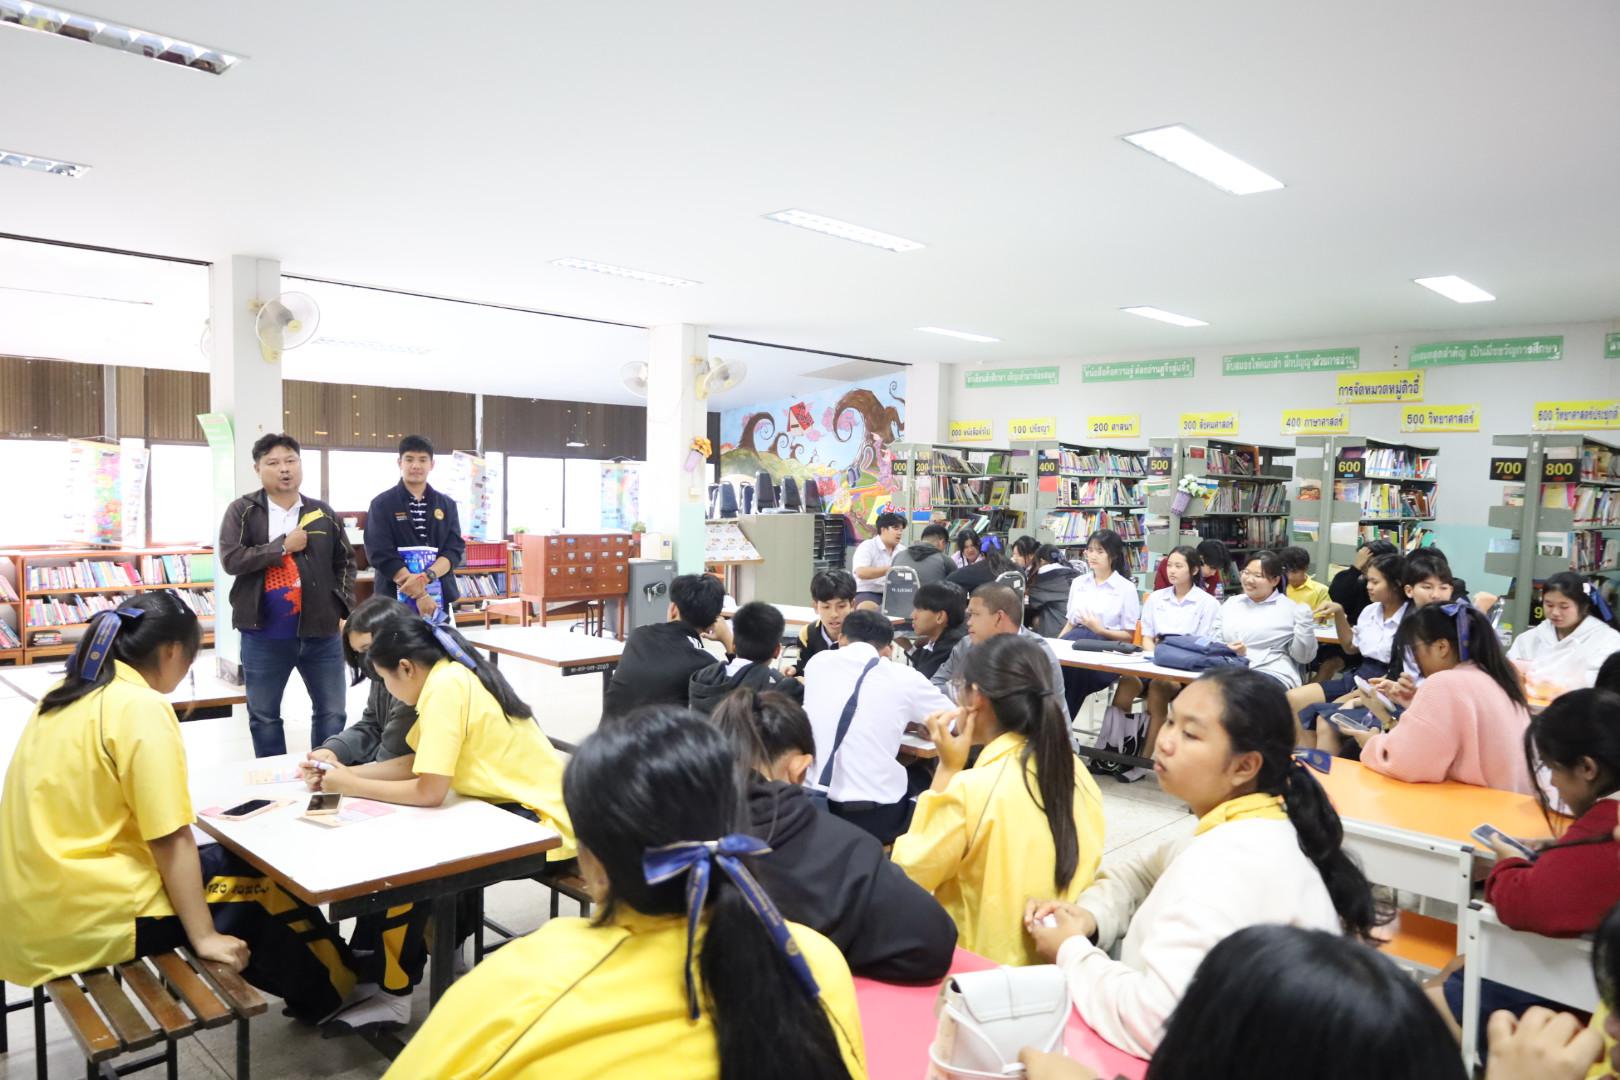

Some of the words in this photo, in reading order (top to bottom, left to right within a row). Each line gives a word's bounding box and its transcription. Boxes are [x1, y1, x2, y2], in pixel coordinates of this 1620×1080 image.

[1338, 374, 1420, 400] การจัดหมวดหมู่ดิวอี้
[1407, 413, 1425, 424] 500
[1428, 410, 1475, 425] วิทยาศาสตร์
[1538, 410, 1553, 421] 600
[1093, 423, 1109, 432] 200
[1183, 420, 1197, 430] 300
[1285, 417, 1301, 428] 400
[1013, 425, 1027, 434] 100
[893, 462, 907, 471] 000
[1039, 461, 1055, 472] 400
[1150, 459, 1169, 471] 500
[1338, 460, 1361, 473] 600
[1495, 461, 1522, 474] 700
[1545, 462, 1574, 476] 800
